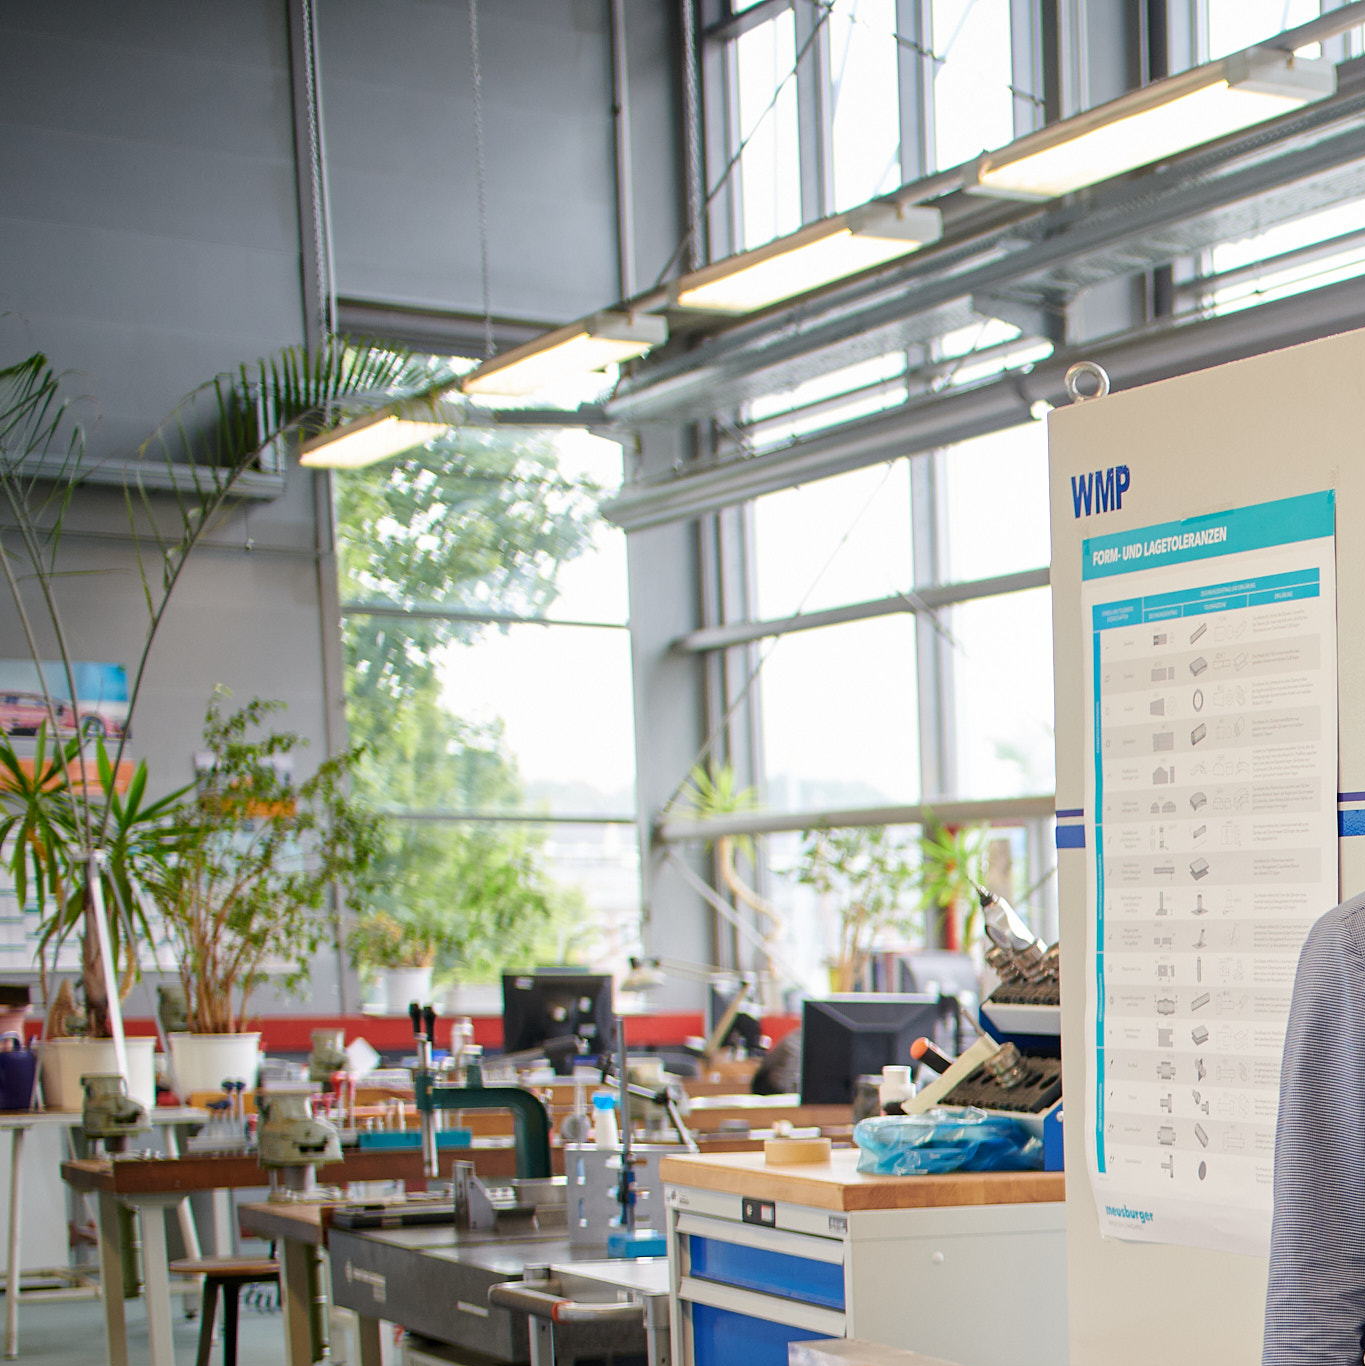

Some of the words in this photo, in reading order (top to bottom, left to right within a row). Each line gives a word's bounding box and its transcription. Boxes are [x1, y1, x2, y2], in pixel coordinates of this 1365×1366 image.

[1071, 465, 1131, 519] WMP
[1092, 547, 1121, 567] FORM-
[1122, 545, 1143, 561] UND
[1144, 526, 1227, 556] LAGETOLERANZEN
[1105, 1204, 1153, 1224] meusburger
